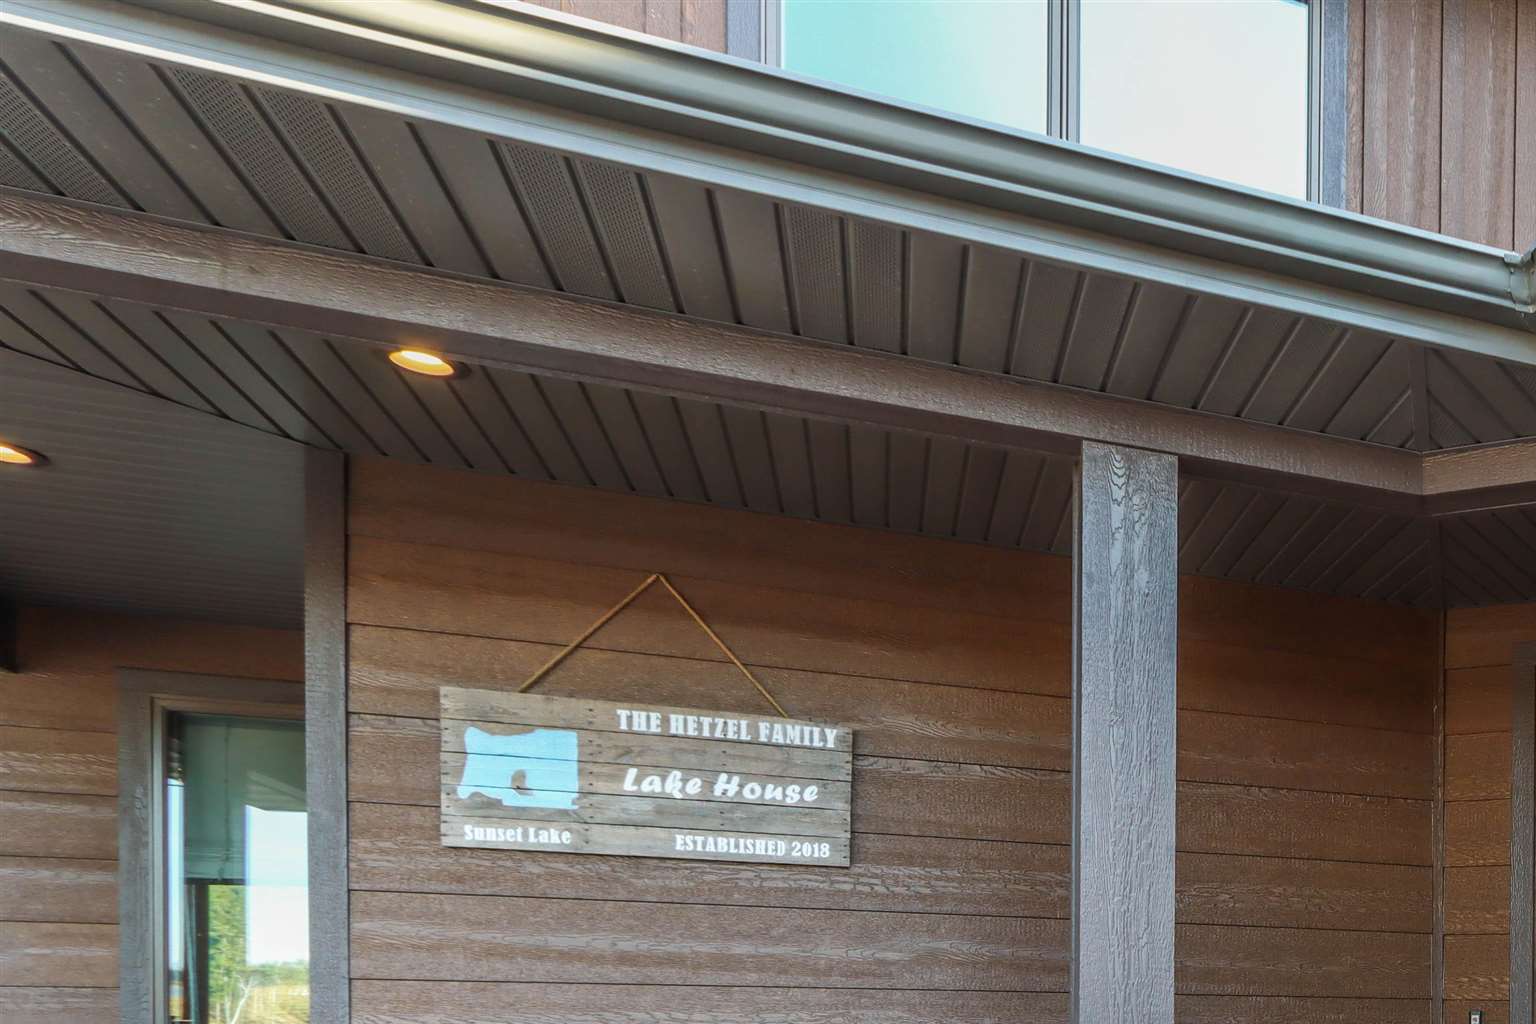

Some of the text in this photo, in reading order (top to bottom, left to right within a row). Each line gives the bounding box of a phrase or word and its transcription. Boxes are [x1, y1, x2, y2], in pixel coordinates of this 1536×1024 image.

[616, 709, 838, 748] THE HETZEL FAMILY
[623, 767, 820, 803] Lake House
[463, 824, 571, 845] Sunset Lake
[675, 834, 830, 858] ESTABLISHED 2018
